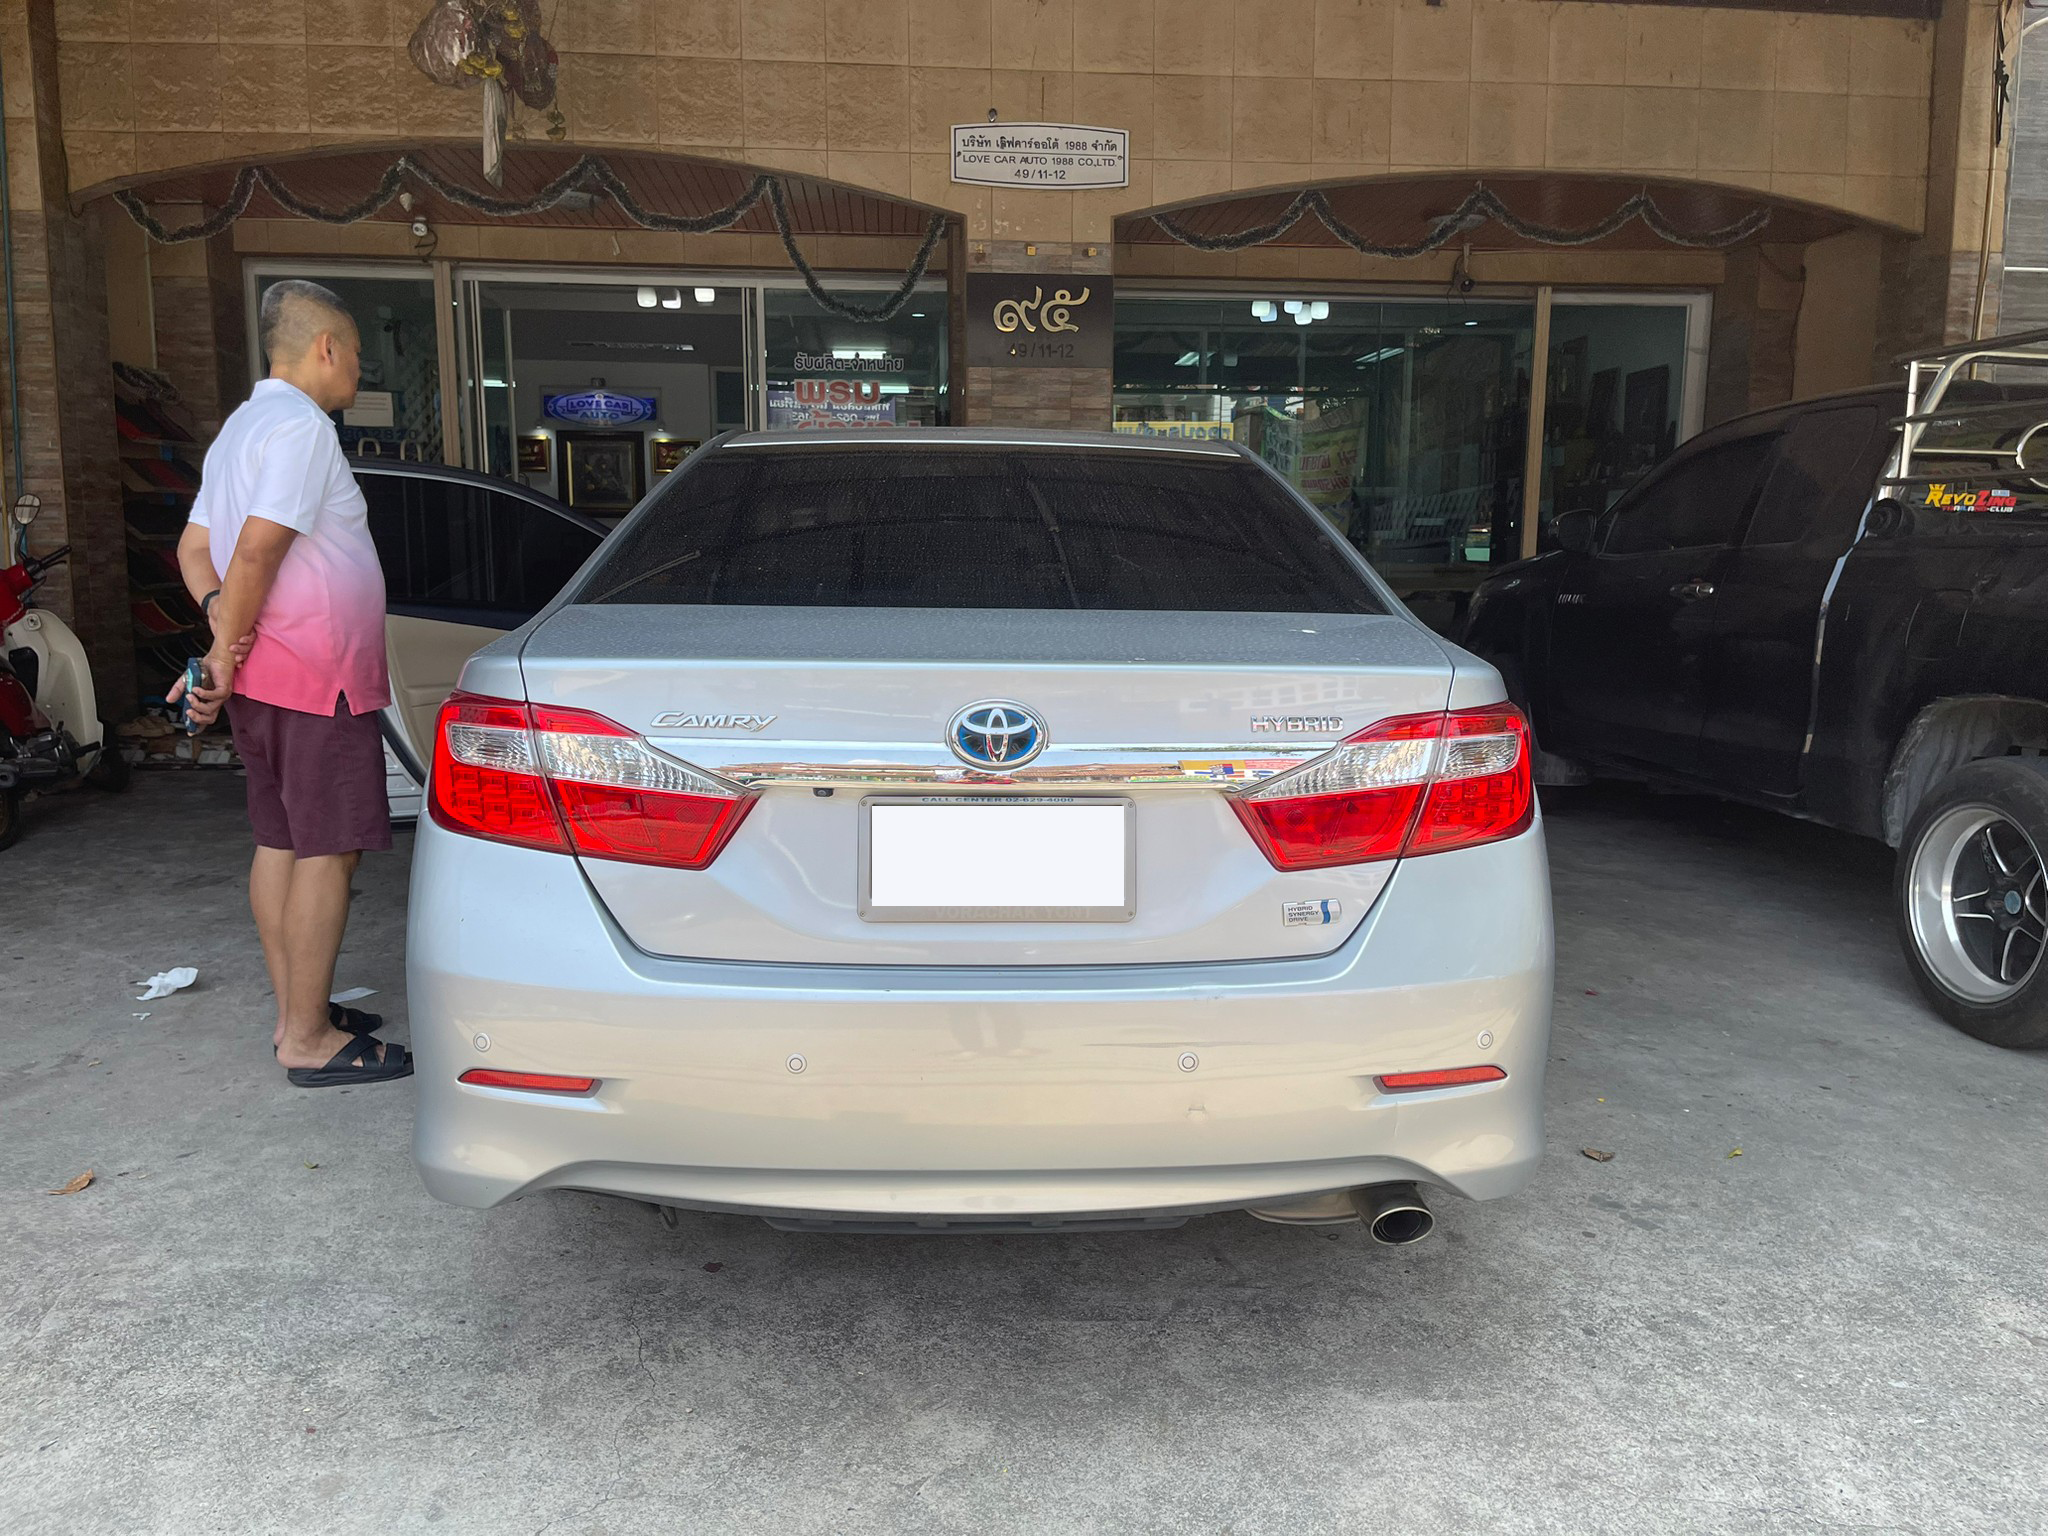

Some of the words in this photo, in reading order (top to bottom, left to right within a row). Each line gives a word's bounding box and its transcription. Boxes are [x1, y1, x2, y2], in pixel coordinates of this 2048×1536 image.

[962, 134, 991, 148] บริษัท
[1065, 141, 1088, 150] 1988
[1092, 139, 1118, 152] จำกัด
[962, 154, 990, 164] LOVE
[994, 155, 1016, 165] CAR
[1019, 156, 1048, 166] AUTO
[1051, 157, 1074, 167] 1988
[794, 379, 880, 405] พรม
[570, 399, 602, 409] LOVE
[604, 401, 629, 411] CAR
[580, 411, 620, 419] AUTO
[650, 710, 778, 733] CAMRY
[1251, 715, 1344, 732] HYBRID
